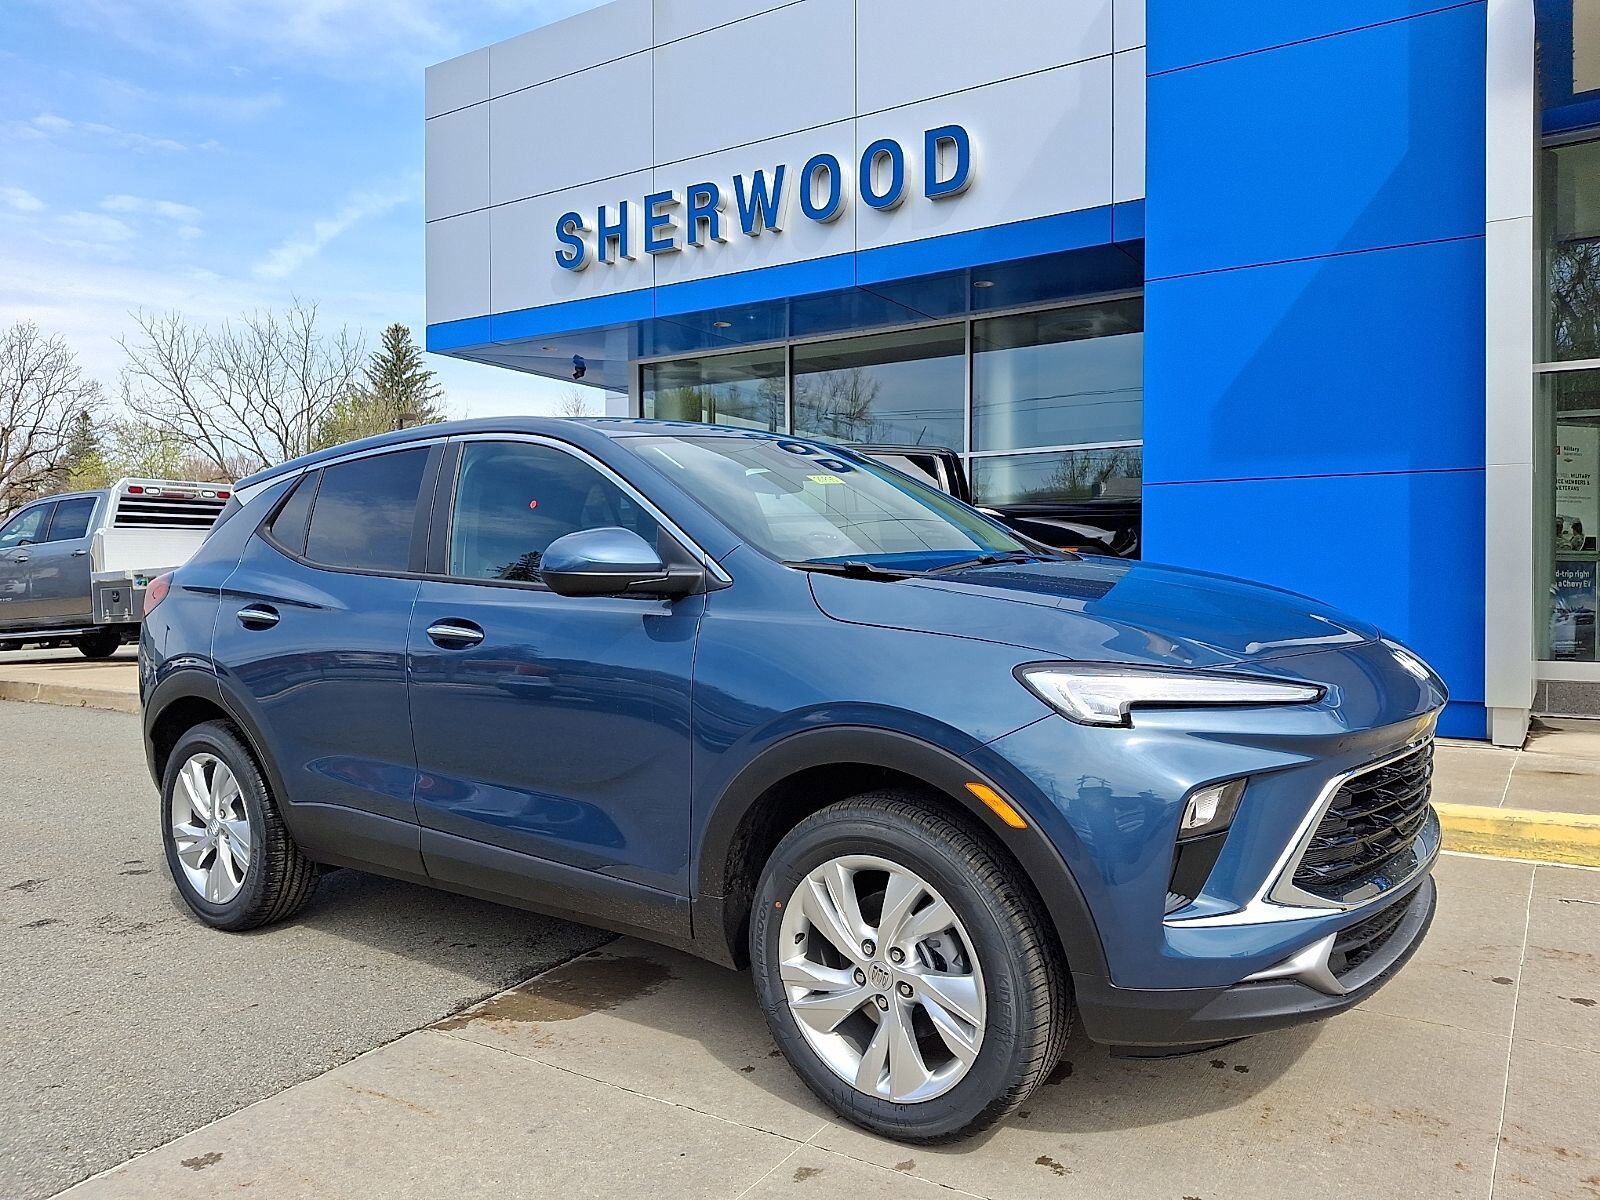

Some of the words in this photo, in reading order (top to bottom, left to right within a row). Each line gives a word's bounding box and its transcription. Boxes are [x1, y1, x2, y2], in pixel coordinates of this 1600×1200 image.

[555, 124, 972, 271] SHERWOOD
[1556, 570, 1574, 579] d-trip
[1574, 570, 1590, 579] right
[1562, 581, 1582, 589] Chevy
